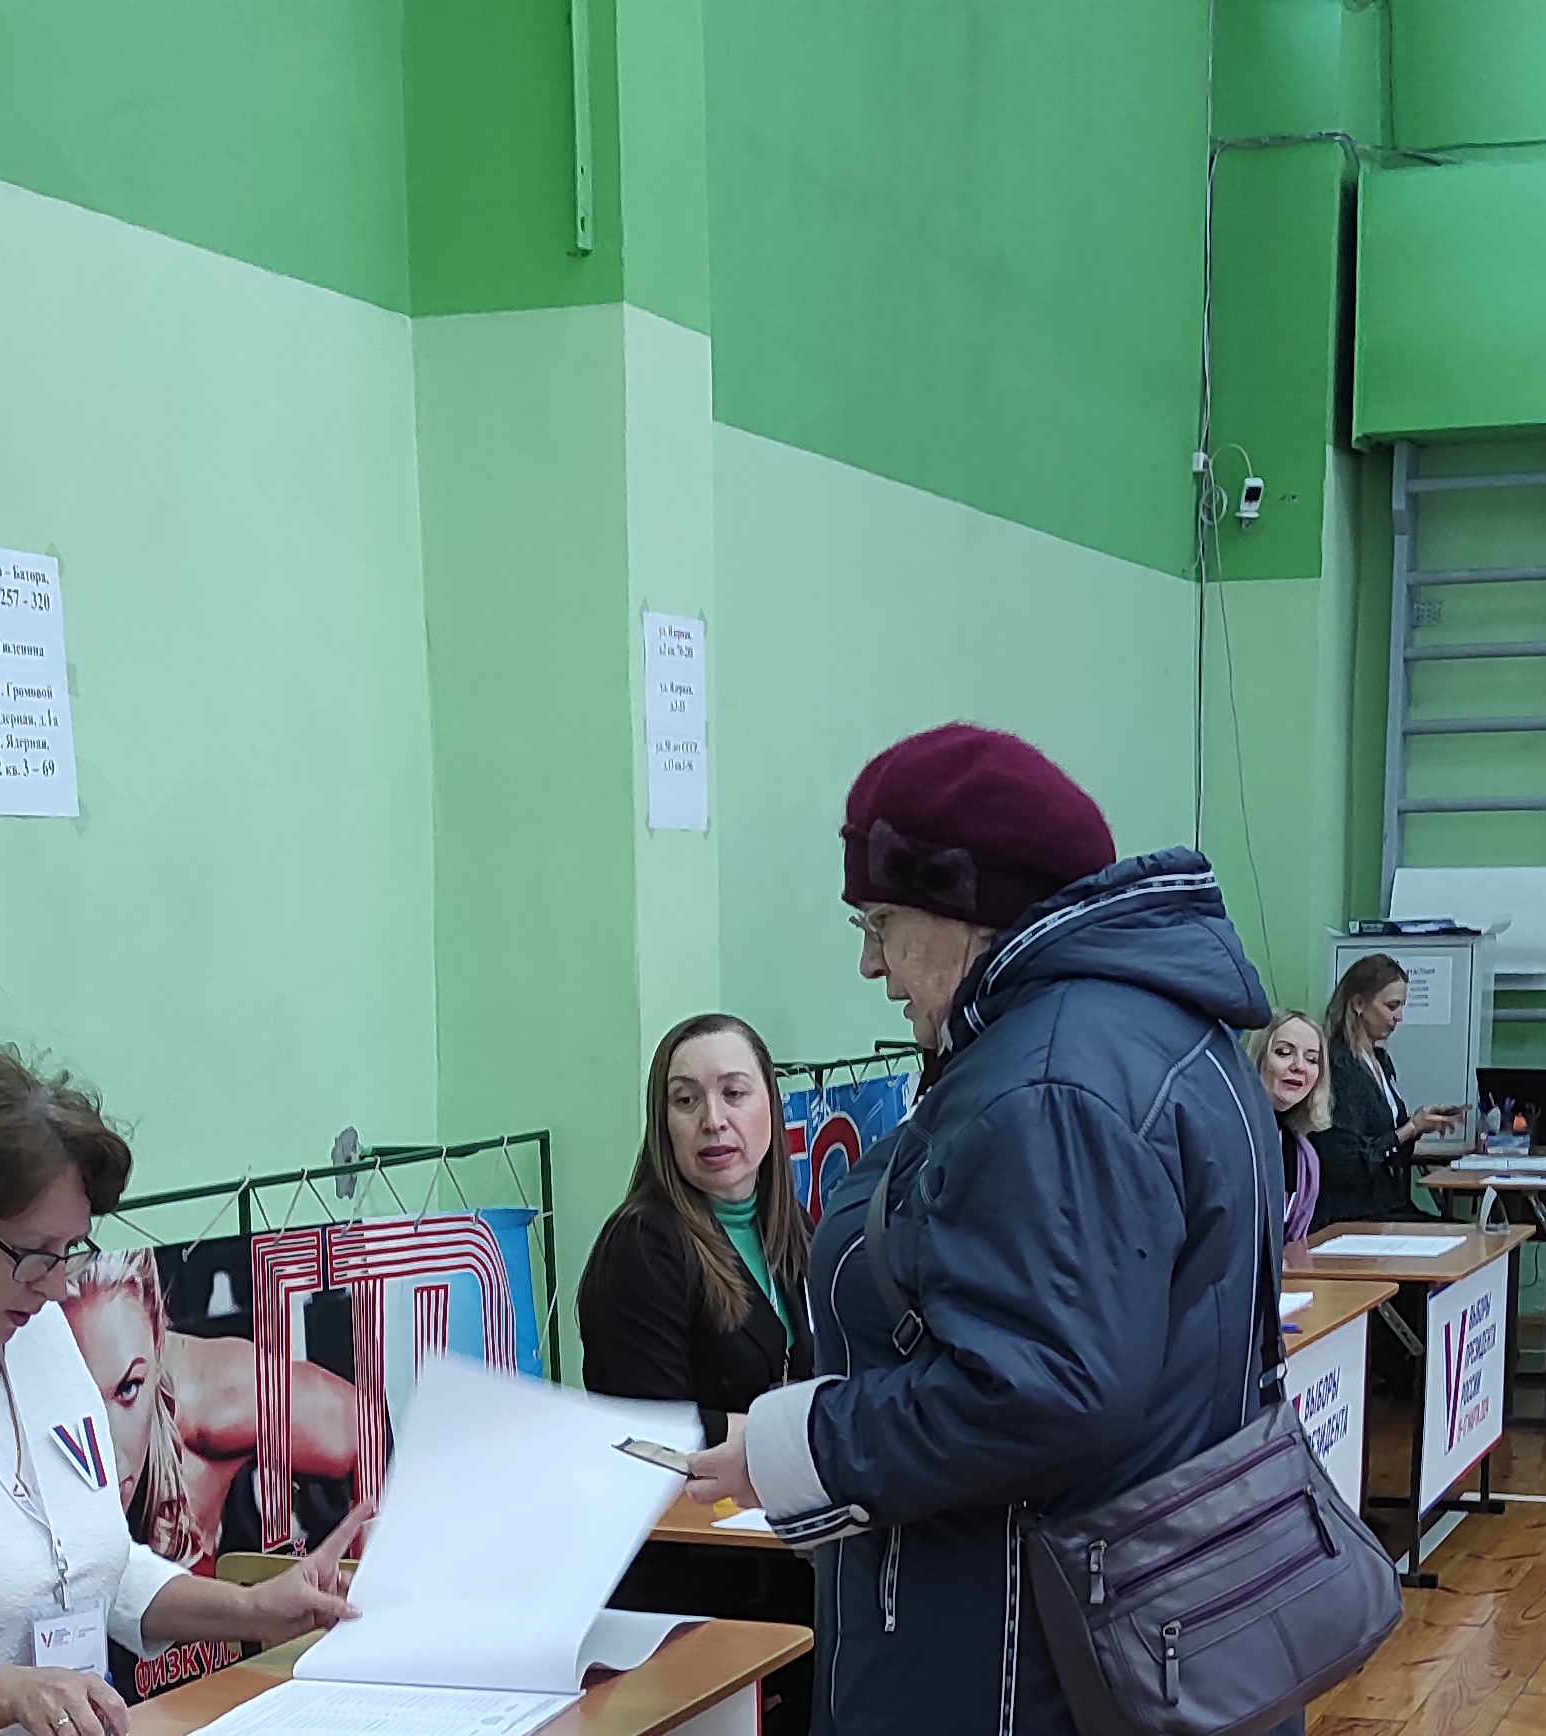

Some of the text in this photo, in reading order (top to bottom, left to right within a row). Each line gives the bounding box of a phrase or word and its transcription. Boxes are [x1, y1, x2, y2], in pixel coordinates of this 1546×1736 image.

[0, 587, 20, 609] 257
[31, 590, 51, 612] 320
[42, 758, 55, 778] 69
[1304, 1365, 1341, 1423] ВЫБОРЫ
